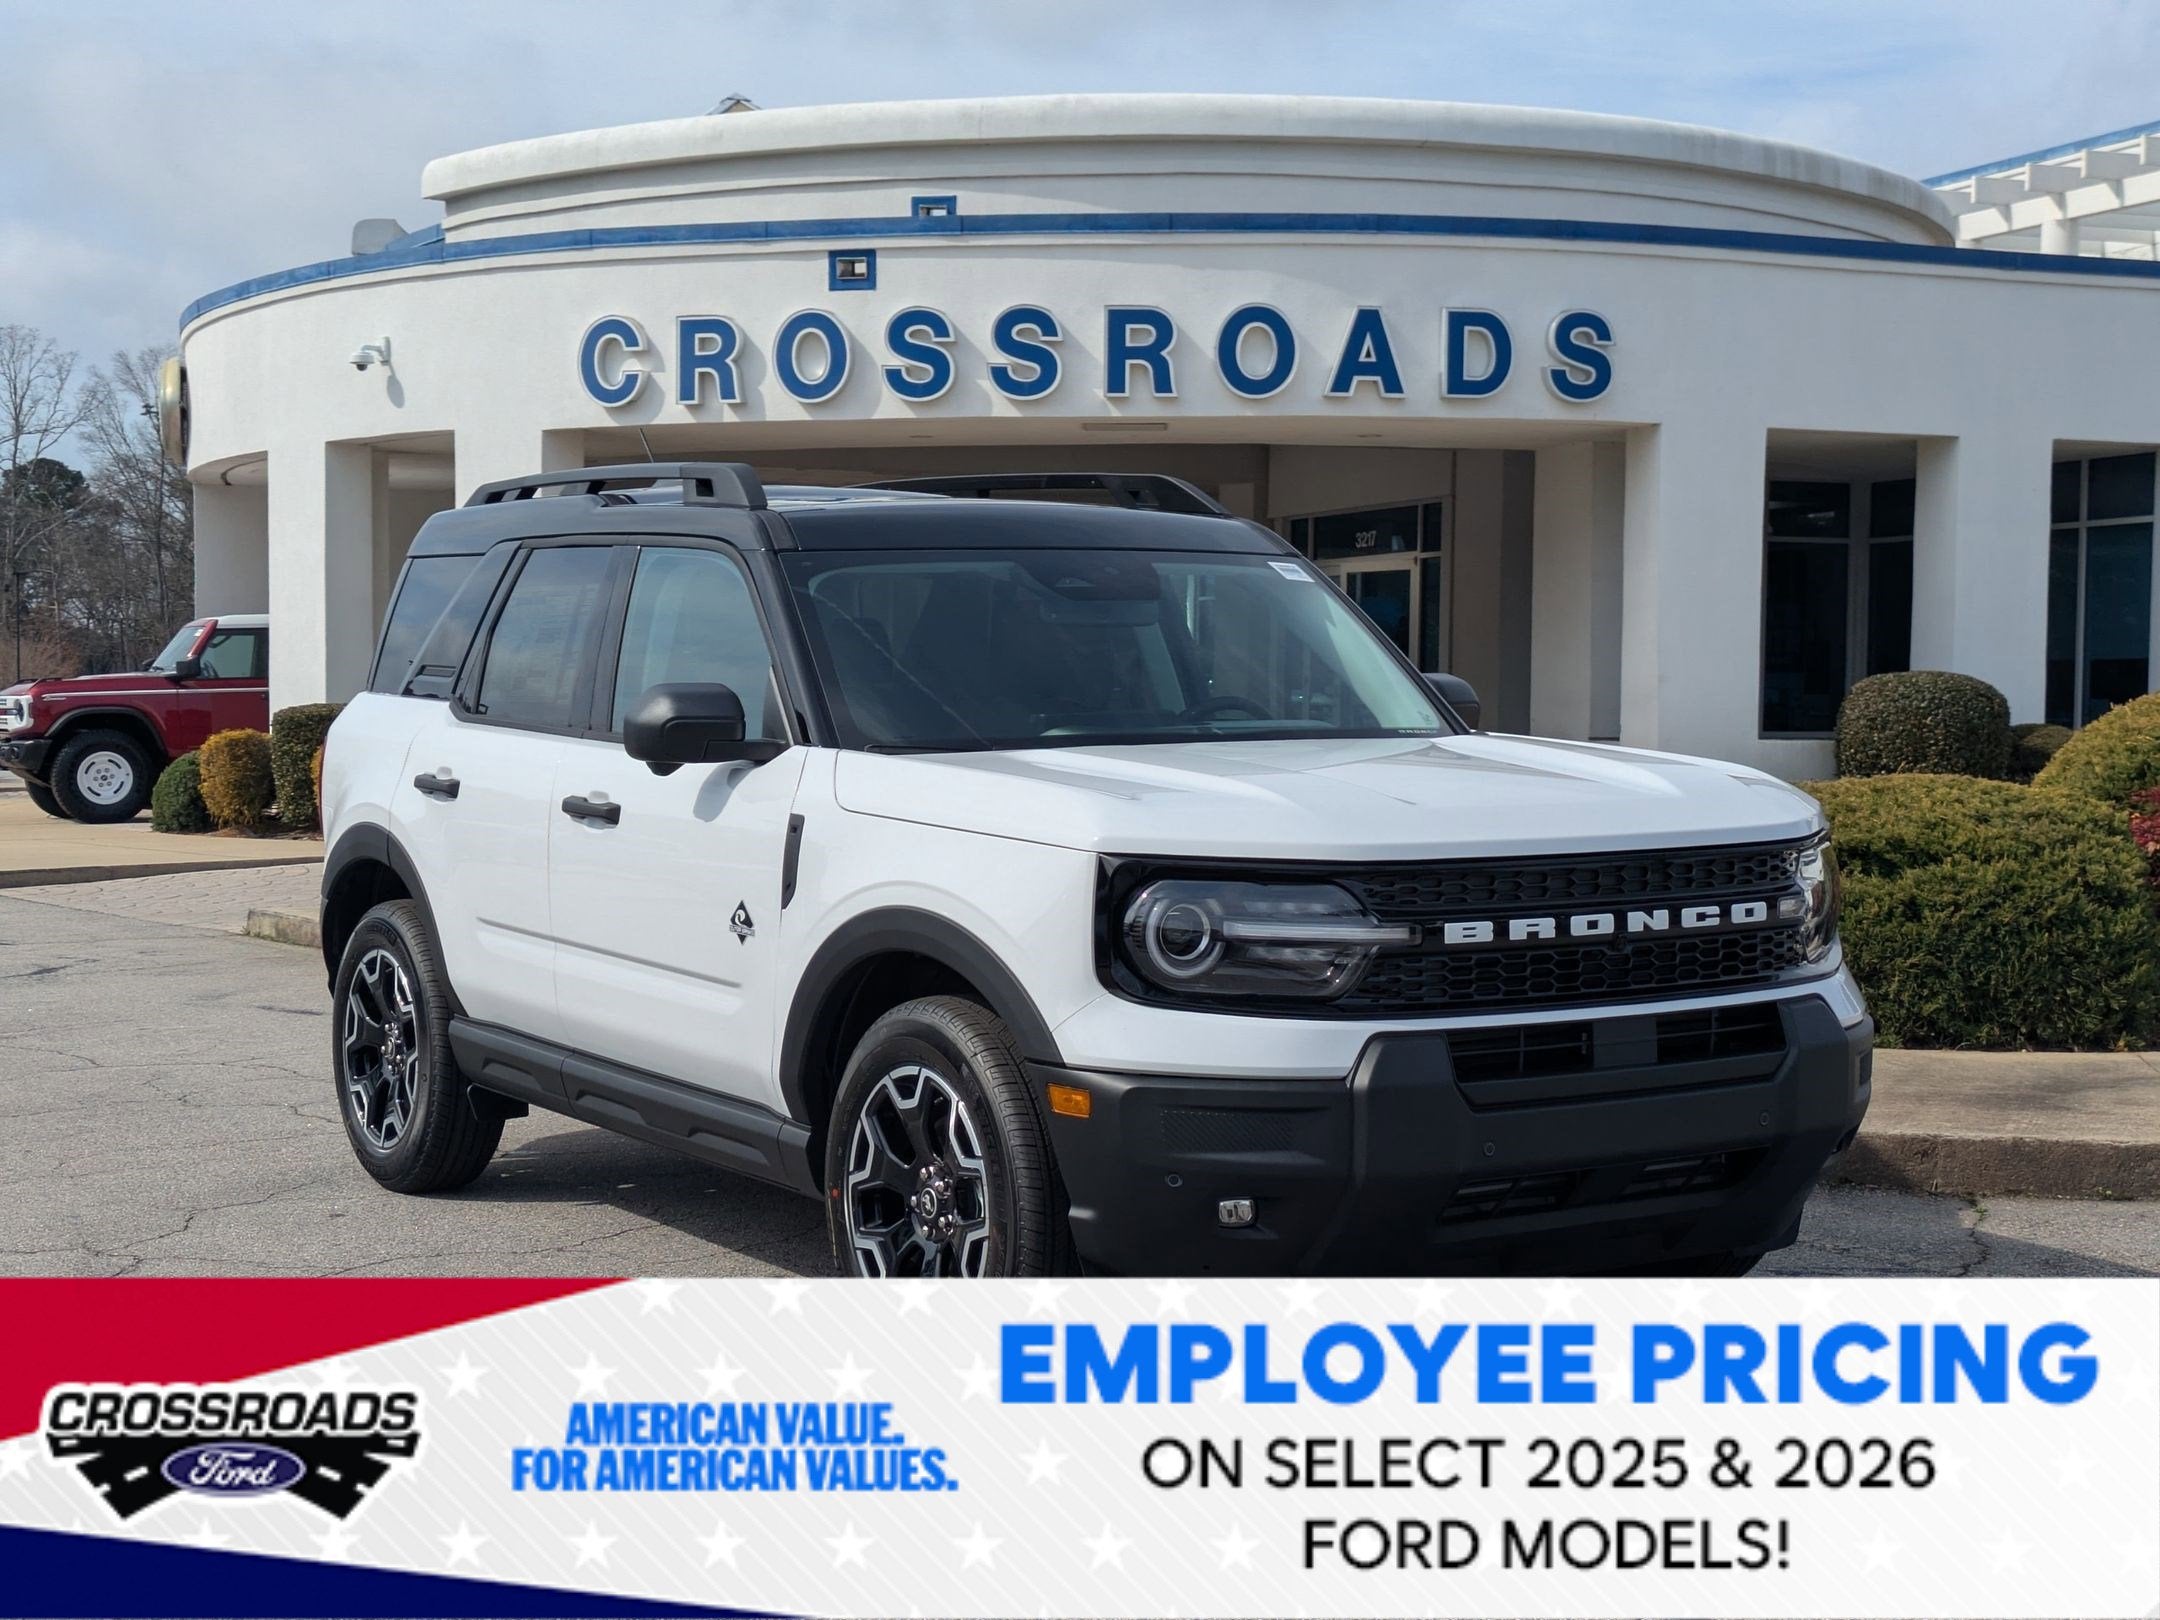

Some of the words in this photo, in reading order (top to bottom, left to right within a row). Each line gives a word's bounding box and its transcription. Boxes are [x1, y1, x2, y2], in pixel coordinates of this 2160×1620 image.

[578, 302, 1615, 406] CROSSROADS
[1355, 531, 1376, 548] 3217
[1444, 901, 1767, 944] BRONCO
